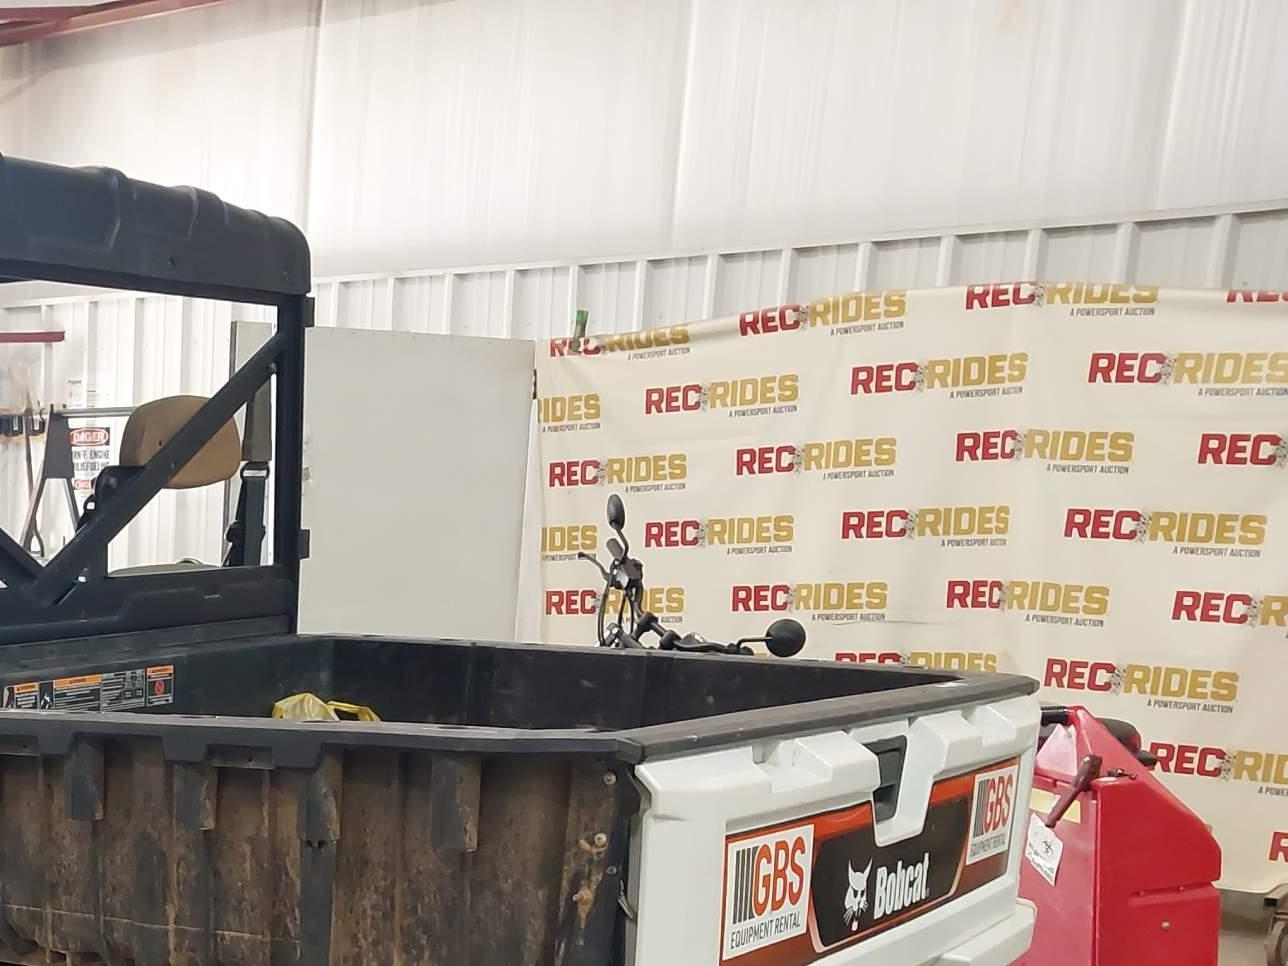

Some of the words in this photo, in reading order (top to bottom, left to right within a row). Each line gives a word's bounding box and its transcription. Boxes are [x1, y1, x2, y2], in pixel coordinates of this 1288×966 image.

[740, 305, 800, 336] REC
[809, 291, 906, 327] RIDES
[836, 324, 876, 336] POWERSPORT
[877, 321, 904, 330] AUCTION
[1076, 308, 1123, 317] POWERSPORT
[1124, 308, 1155, 317] AUCTION
[606, 328, 690, 352] RIDES
[851, 362, 918, 395] REC
[926, 353, 1028, 389] RIDES
[1088, 353, 1167, 384] REC
[1174, 353, 1288, 384] RIDES
[538, 394, 601, 423] IDES
[645, 384, 703, 415] REC
[709, 374, 799, 408] RIDES
[1205, 387, 1255, 397] POWERSPORT
[734, 407, 771, 418] POWERSPORT
[773, 405, 798, 414] AUCTION
[736, 445, 796, 475] REC
[804, 437, 897, 471] RIDES
[956, 430, 1017, 461] REC
[1024, 429, 1135, 462] RIDES
[1198, 433, 1283, 466] REC
[549, 460, 600, 487] REC
[607, 454, 687, 484] RIDES
[1053, 464, 1098, 474] POWERSPORT
[1099, 465, 1129, 474] AUCTION
[645, 520, 700, 548] REC
[707, 515, 794, 545] RIDES
[841, 509, 910, 539] REC
[917, 506, 1010, 537] RIDES
[1064, 509, 1143, 540] REC
[1148, 512, 1268, 545] RIDES
[1180, 547, 1227, 557] POWERSPORT
[1230, 548, 1261, 558] AUCTION
[545, 590, 597, 615] REC
[732, 584, 791, 612] REC
[795, 582, 889, 611] RIDES
[947, 580, 1002, 609] REC
[1007, 580, 1110, 616] RIDES
[1172, 590, 1253, 625] REC
[1032, 614, 1073, 626] POWERSPORT
[1074, 618, 1104, 628] AUCTION
[1044, 658, 1117, 692] REC
[1123, 663, 1240, 703] RIDES
[1153, 700, 1201, 712] POWERSPORT
[1202, 703, 1233, 714] AUCTION
[1148, 742, 1227, 778] REC
[984, 774, 1013, 834] GBS
[751, 835, 806, 917] GBS
[873, 852, 930, 920] Bobcat
[730, 918, 775, 950] EQUIPMENT
[775, 911, 801, 937] RENTAL
